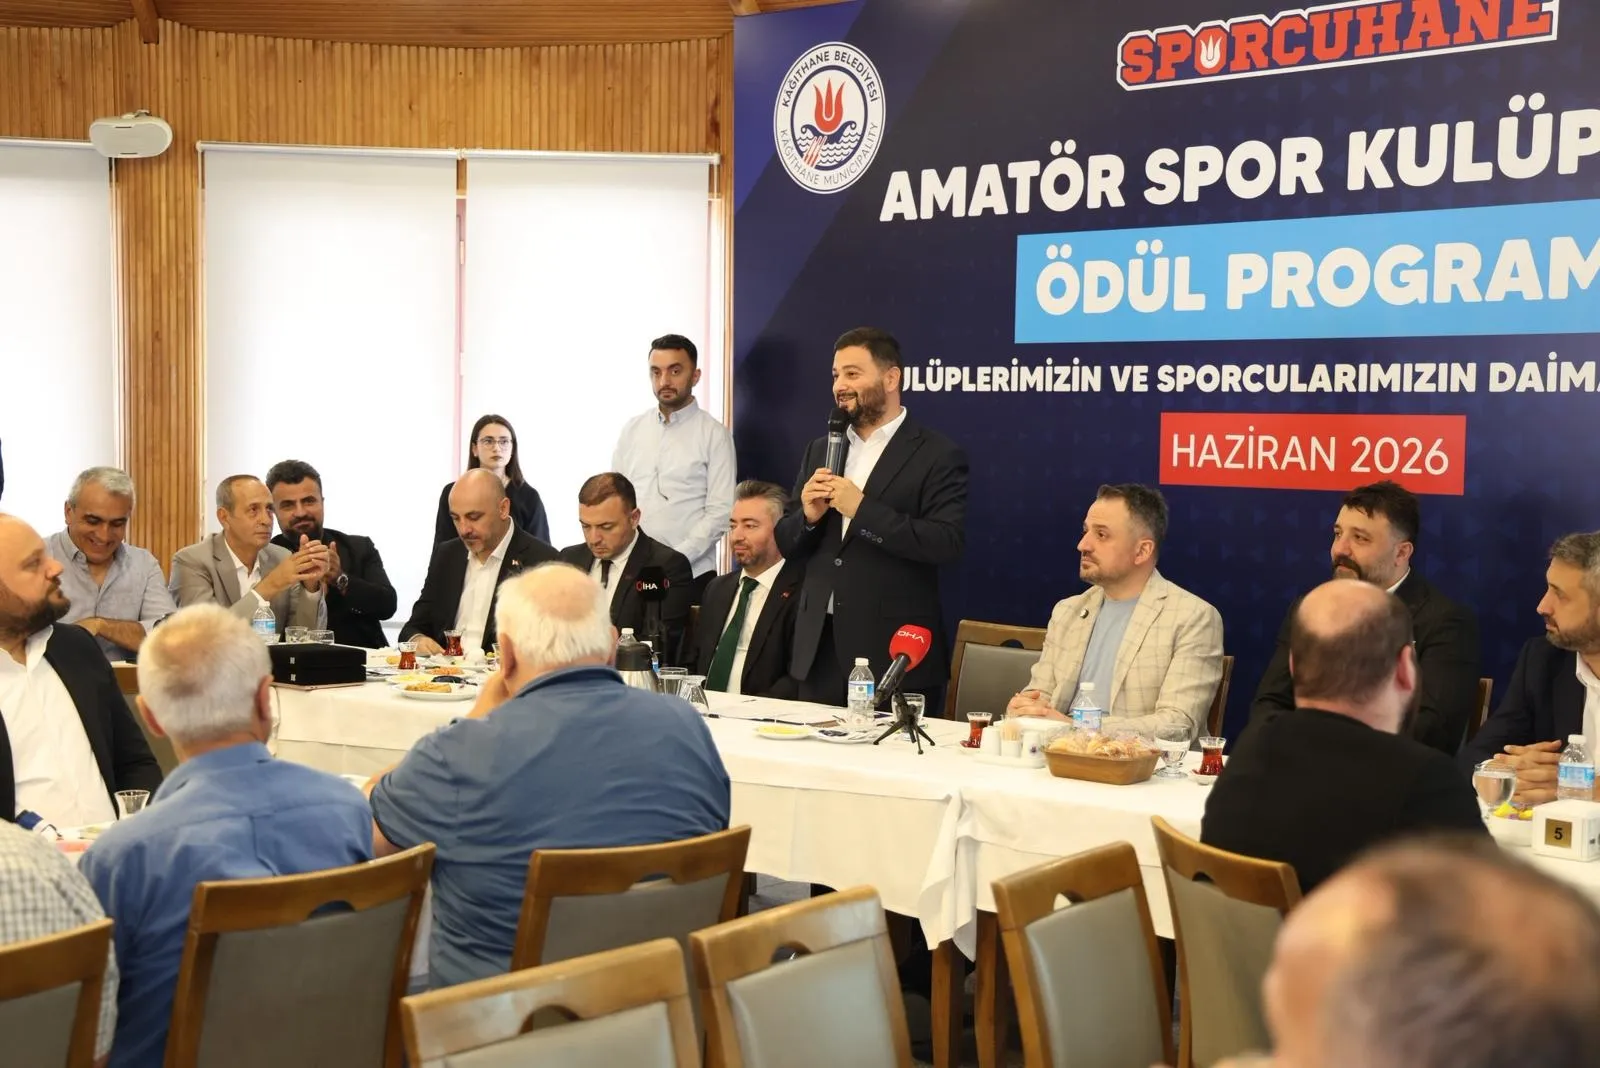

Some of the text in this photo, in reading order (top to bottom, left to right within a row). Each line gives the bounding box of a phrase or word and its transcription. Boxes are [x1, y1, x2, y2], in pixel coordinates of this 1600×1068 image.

[1121, 0, 1551, 84] SPORCUHANE
[834, 50, 881, 102] BELEDİYESİ
[823, 121, 879, 186] MUNICIPALITY
[878, 92, 1600, 221] AMATÖR SPOR KULÜP
[1036, 236, 1600, 315] ÖDÜL PROGRAM
[1110, 365, 1149, 392] VE
[1156, 362, 1477, 393] SPORCULARIMIZIN
[1488, 351, 1600, 392] DAİM
[1172, 425, 1449, 475] HAZİRAN 2026
[897, 630, 924, 644] DHA
[1554, 827, 1563, 840] 5
